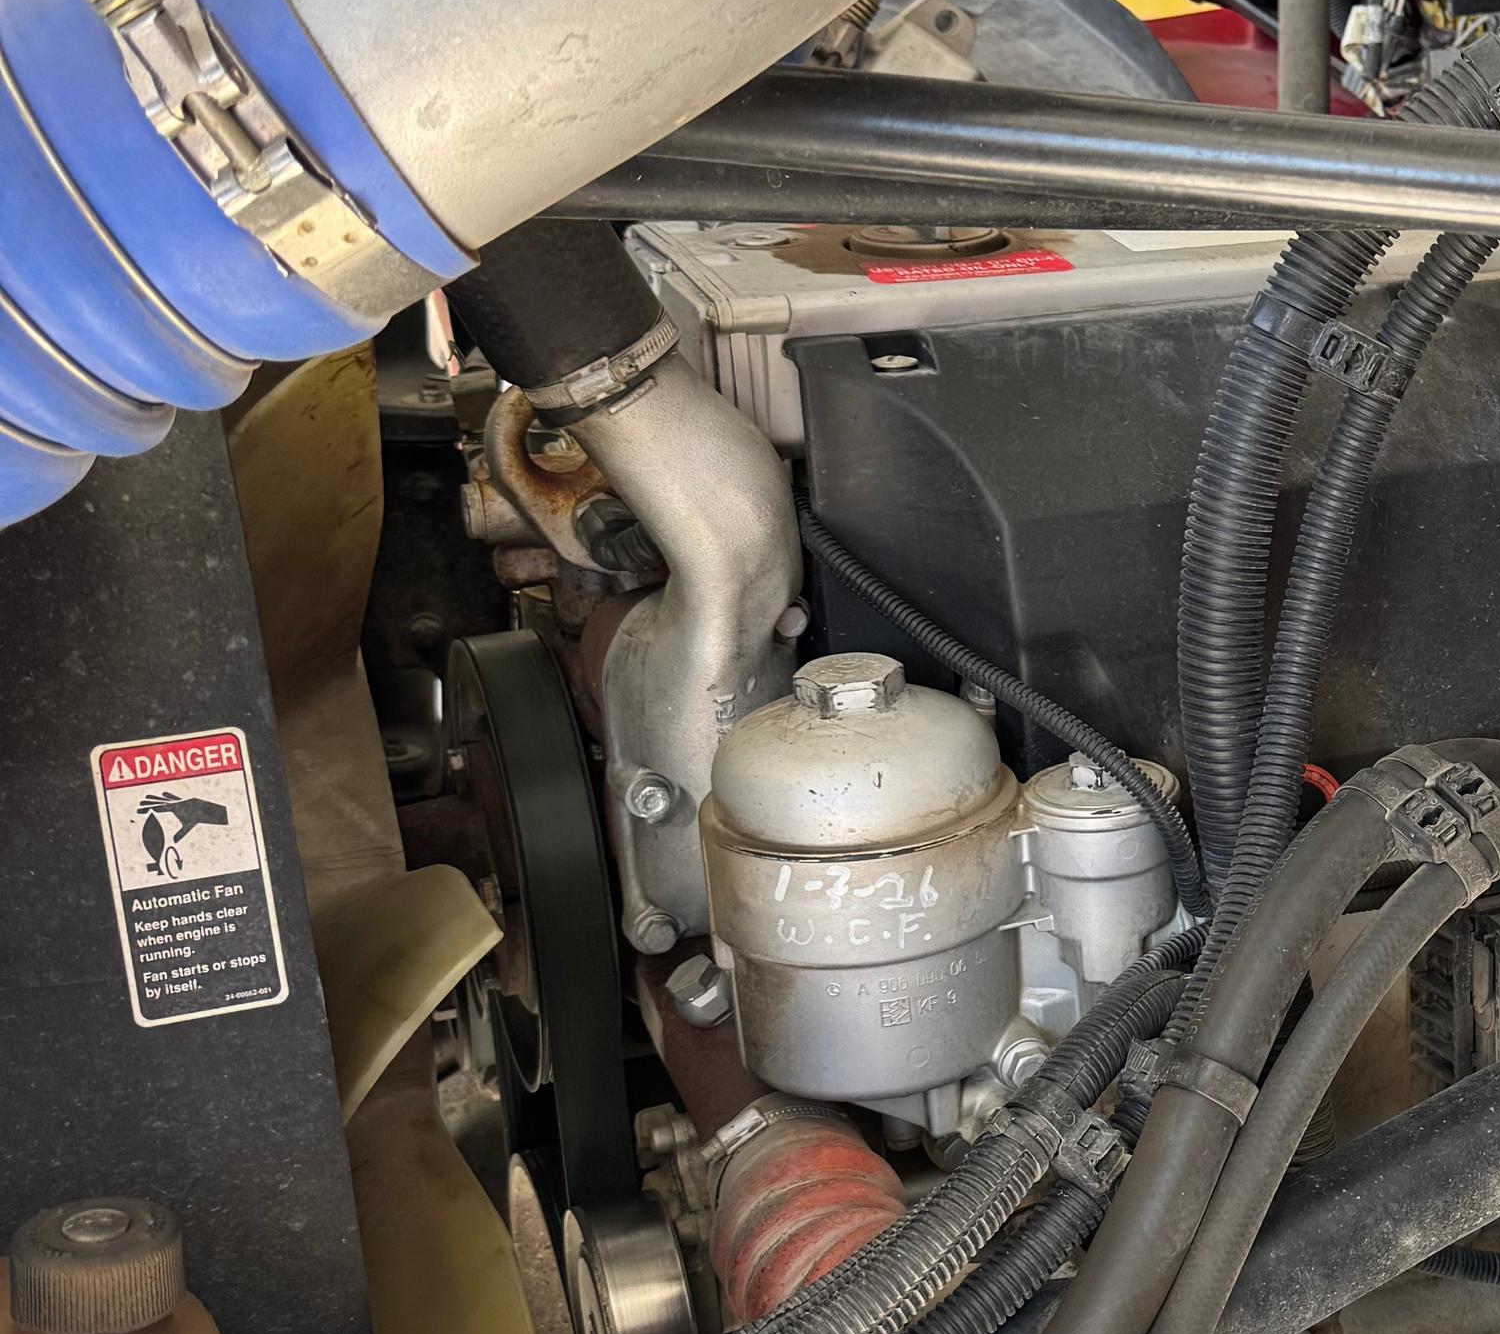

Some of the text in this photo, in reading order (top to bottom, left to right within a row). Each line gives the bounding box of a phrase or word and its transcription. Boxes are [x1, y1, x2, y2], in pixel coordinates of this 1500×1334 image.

[134, 743, 239, 779] DANGER
[131, 883, 244, 913] Automatic Fan
[134, 905, 249, 937] Keep hands clear
[137, 922, 237, 948] when engine is
[139, 948, 196, 964] running.
[143, 952, 268, 984] Fan starts or stops
[145, 978, 203, 1000] by itself.
